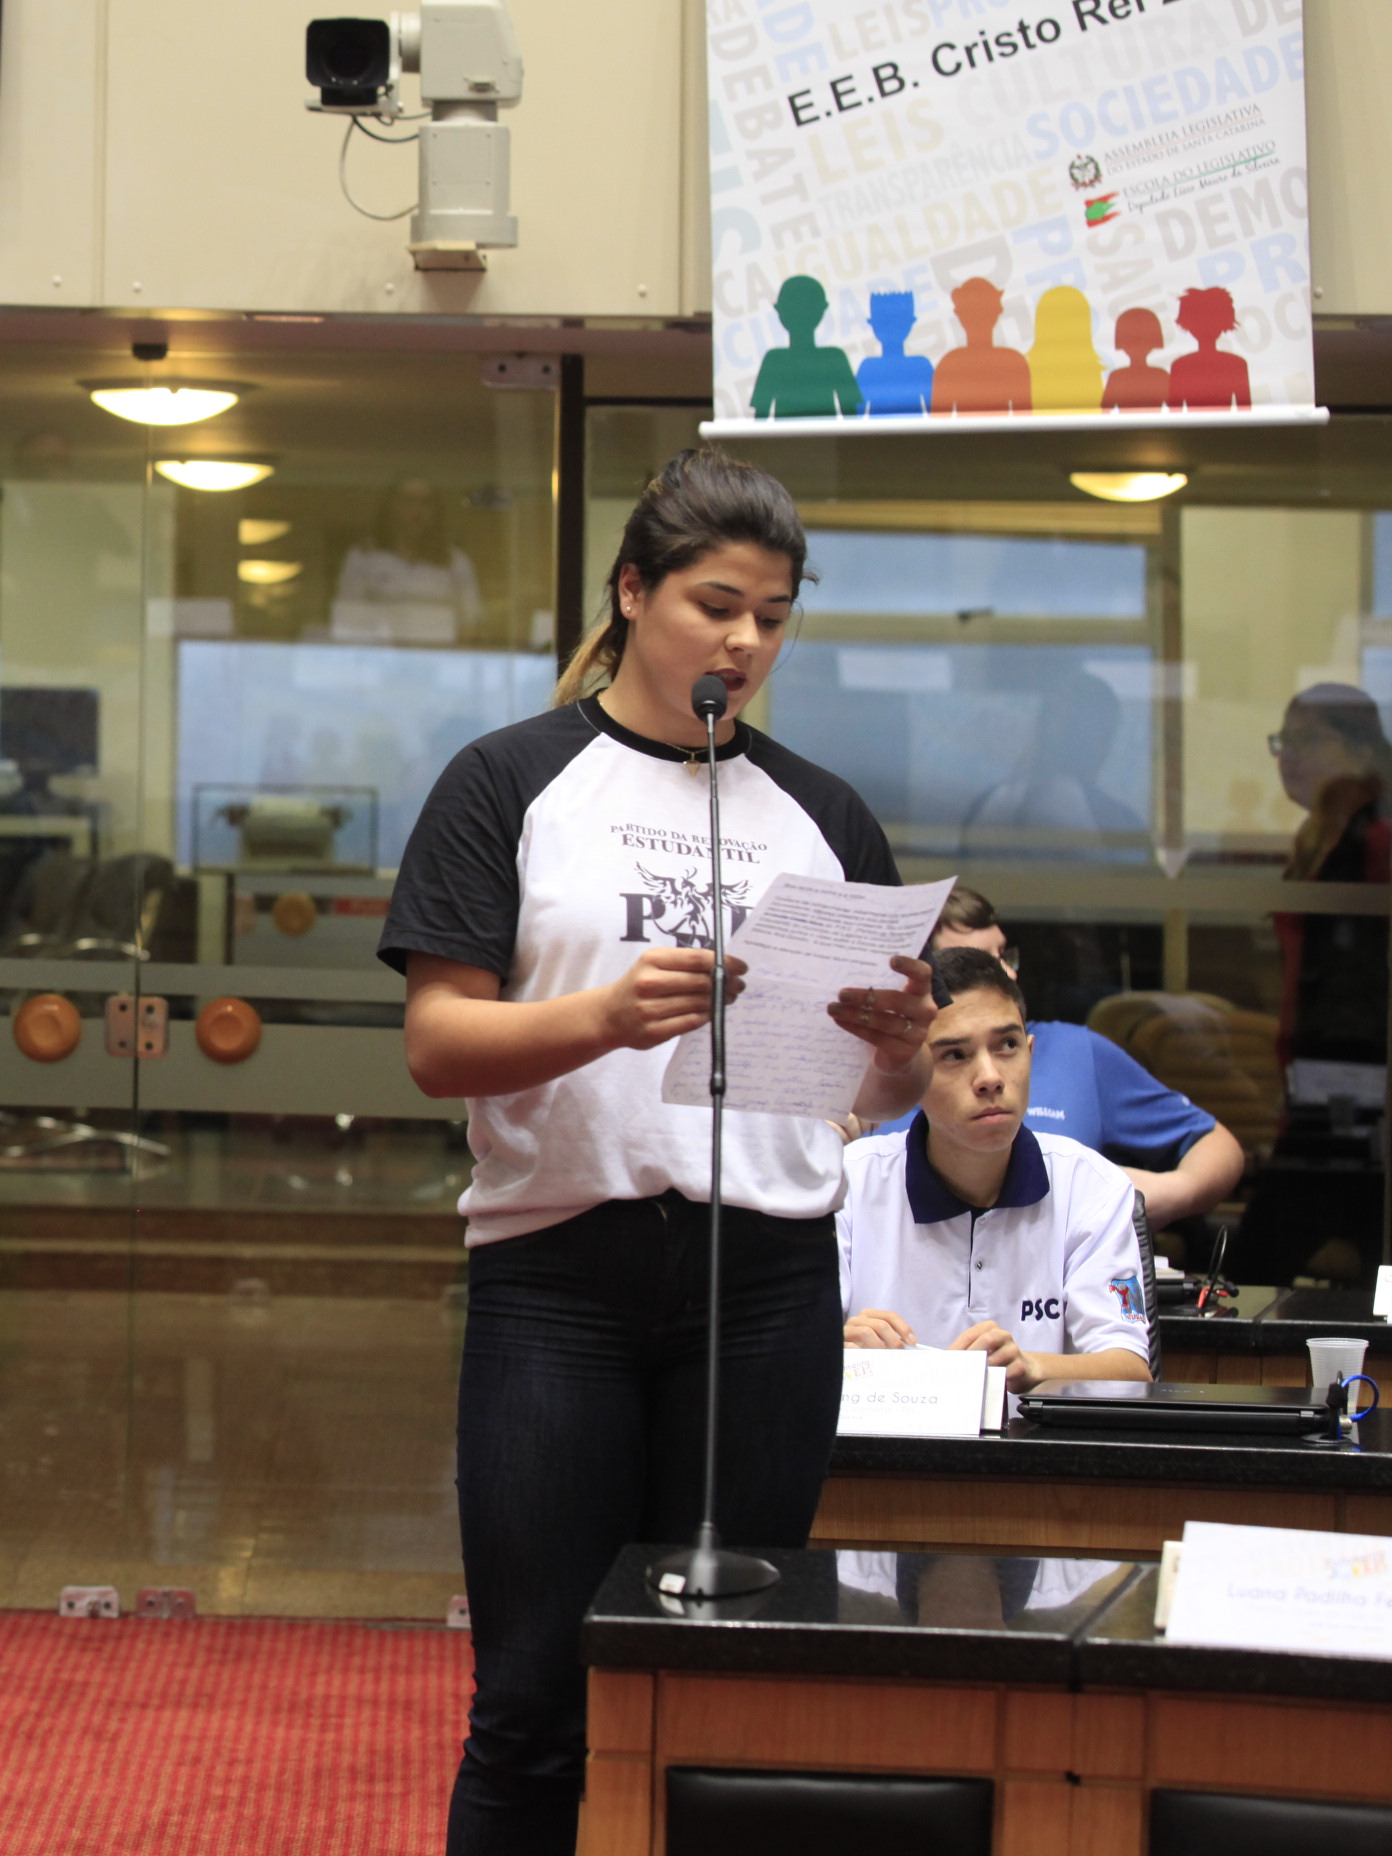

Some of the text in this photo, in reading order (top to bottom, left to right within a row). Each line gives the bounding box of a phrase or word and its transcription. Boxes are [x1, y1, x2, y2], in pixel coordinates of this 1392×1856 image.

[786, 59, 921, 129] E.E.B.
[930, 15, 1063, 79] Cristo
[806, 96, 945, 187] LEIS
[1104, 102, 1262, 164] ASSEMBLEIA LEGISLATIVA
[1197, 138, 1277, 177] LEGISLATIVO
[610, 823, 768, 851] PARTIDO DA REOVAÇÃO
[1020, 1297, 1061, 1322] PSC
[866, 1391, 886, 1404] de
[891, 1391, 938, 1405] Souza
[1227, 1581, 1289, 1601] Luana
[1293, 1585, 1368, 1607] Padilha
